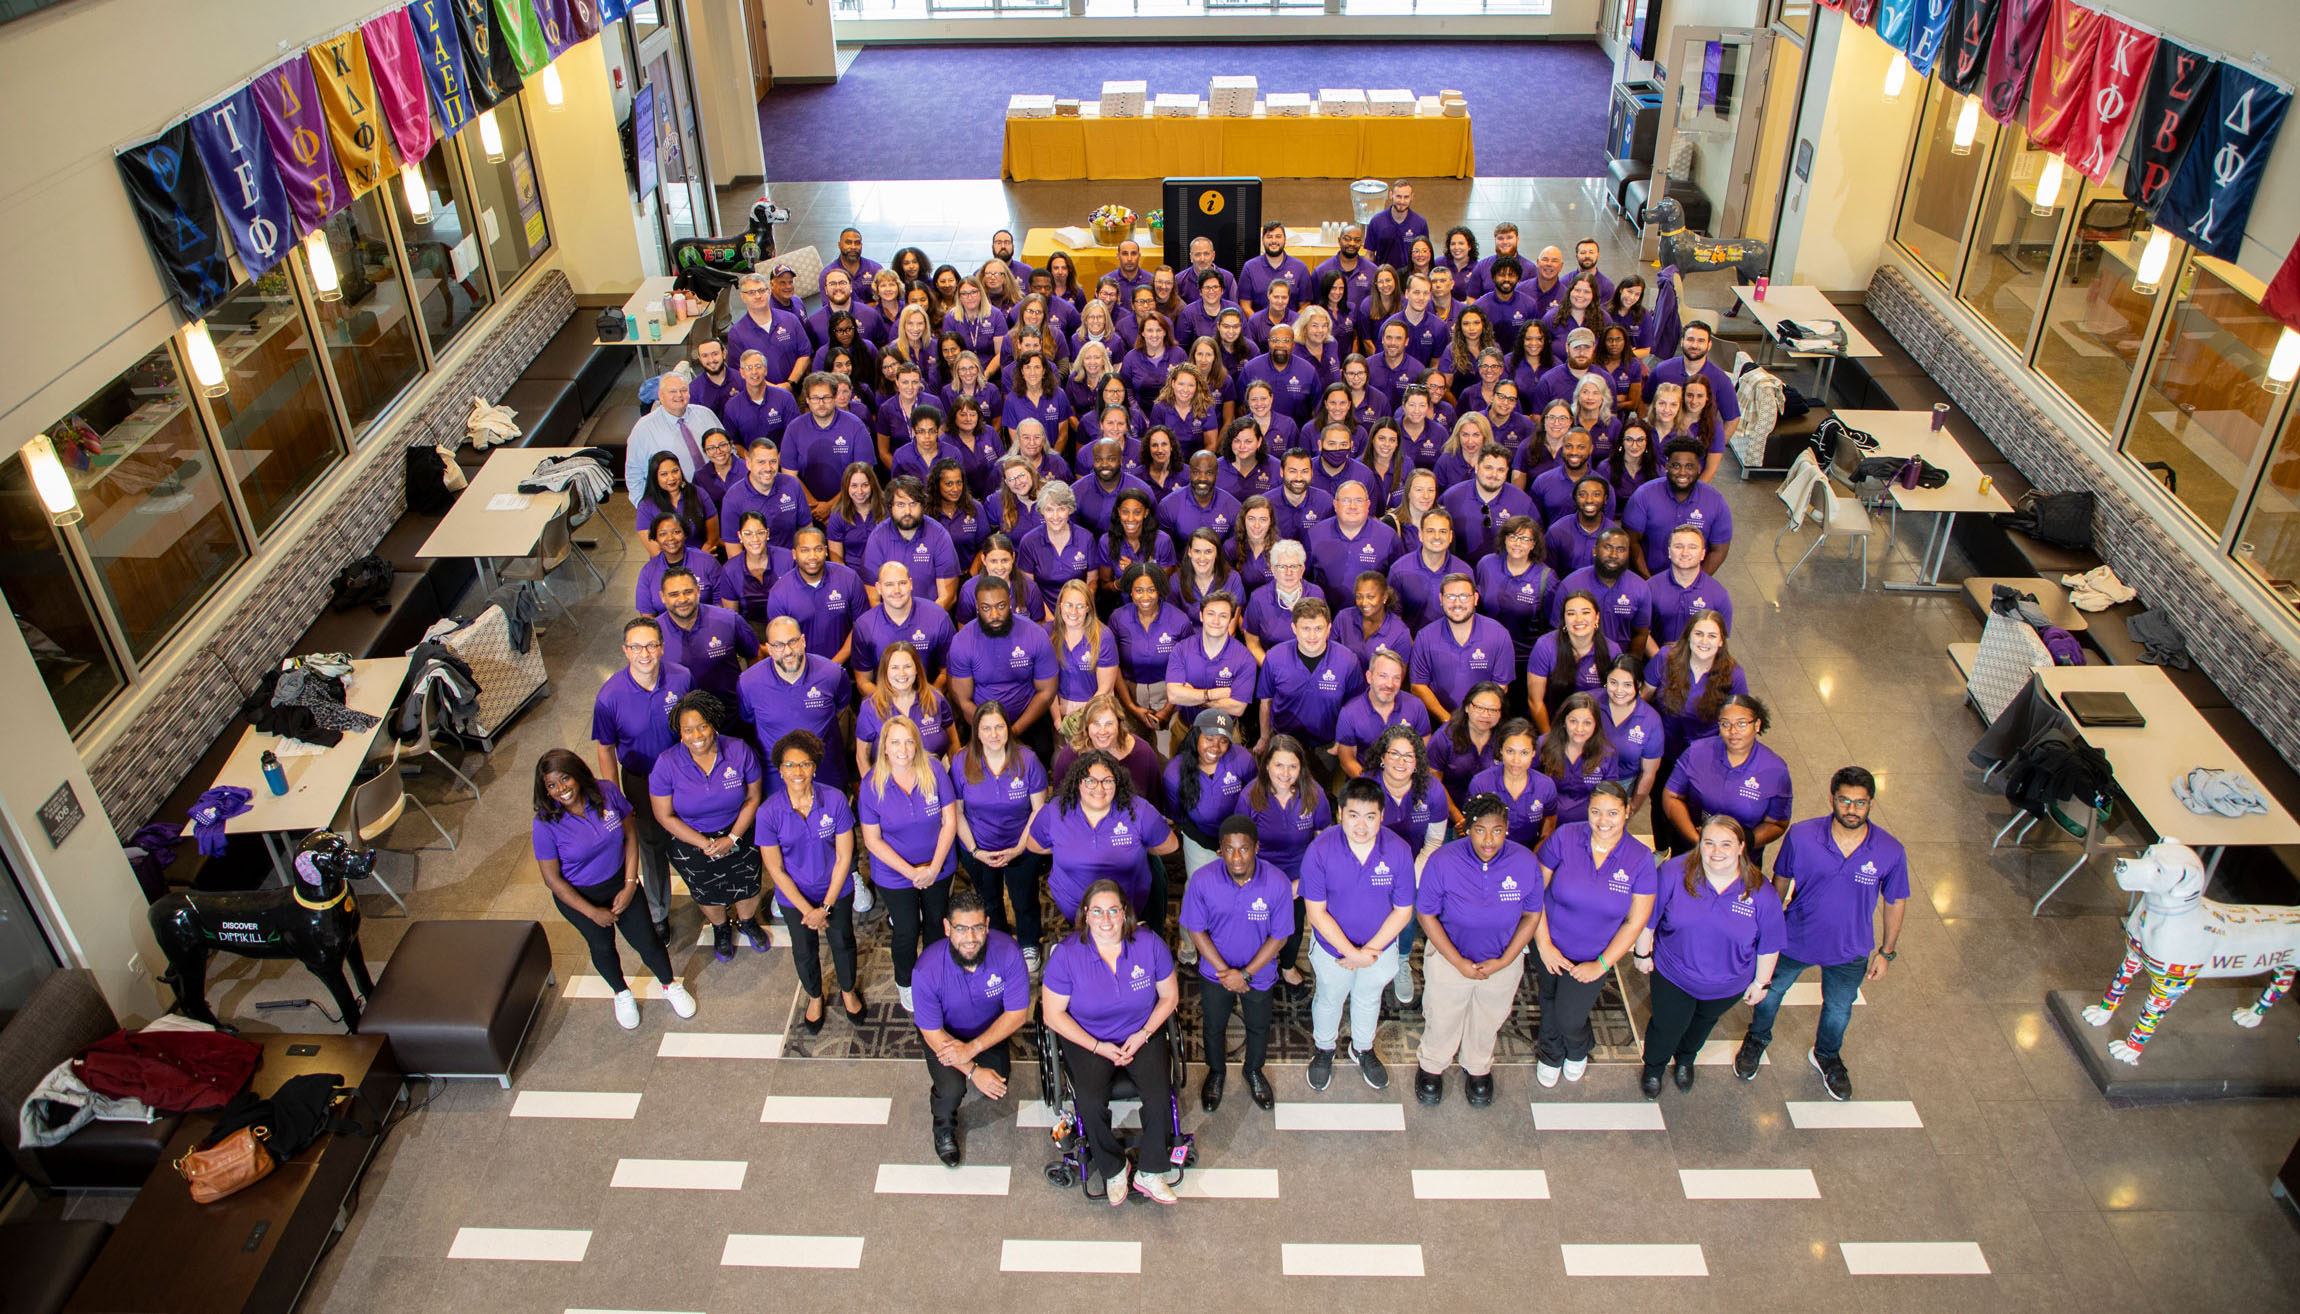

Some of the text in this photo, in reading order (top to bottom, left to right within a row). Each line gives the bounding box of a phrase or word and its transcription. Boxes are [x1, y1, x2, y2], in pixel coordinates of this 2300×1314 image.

[222, 921, 258, 930] DISCOVER
[2211, 948, 2295, 969] WE ARE
